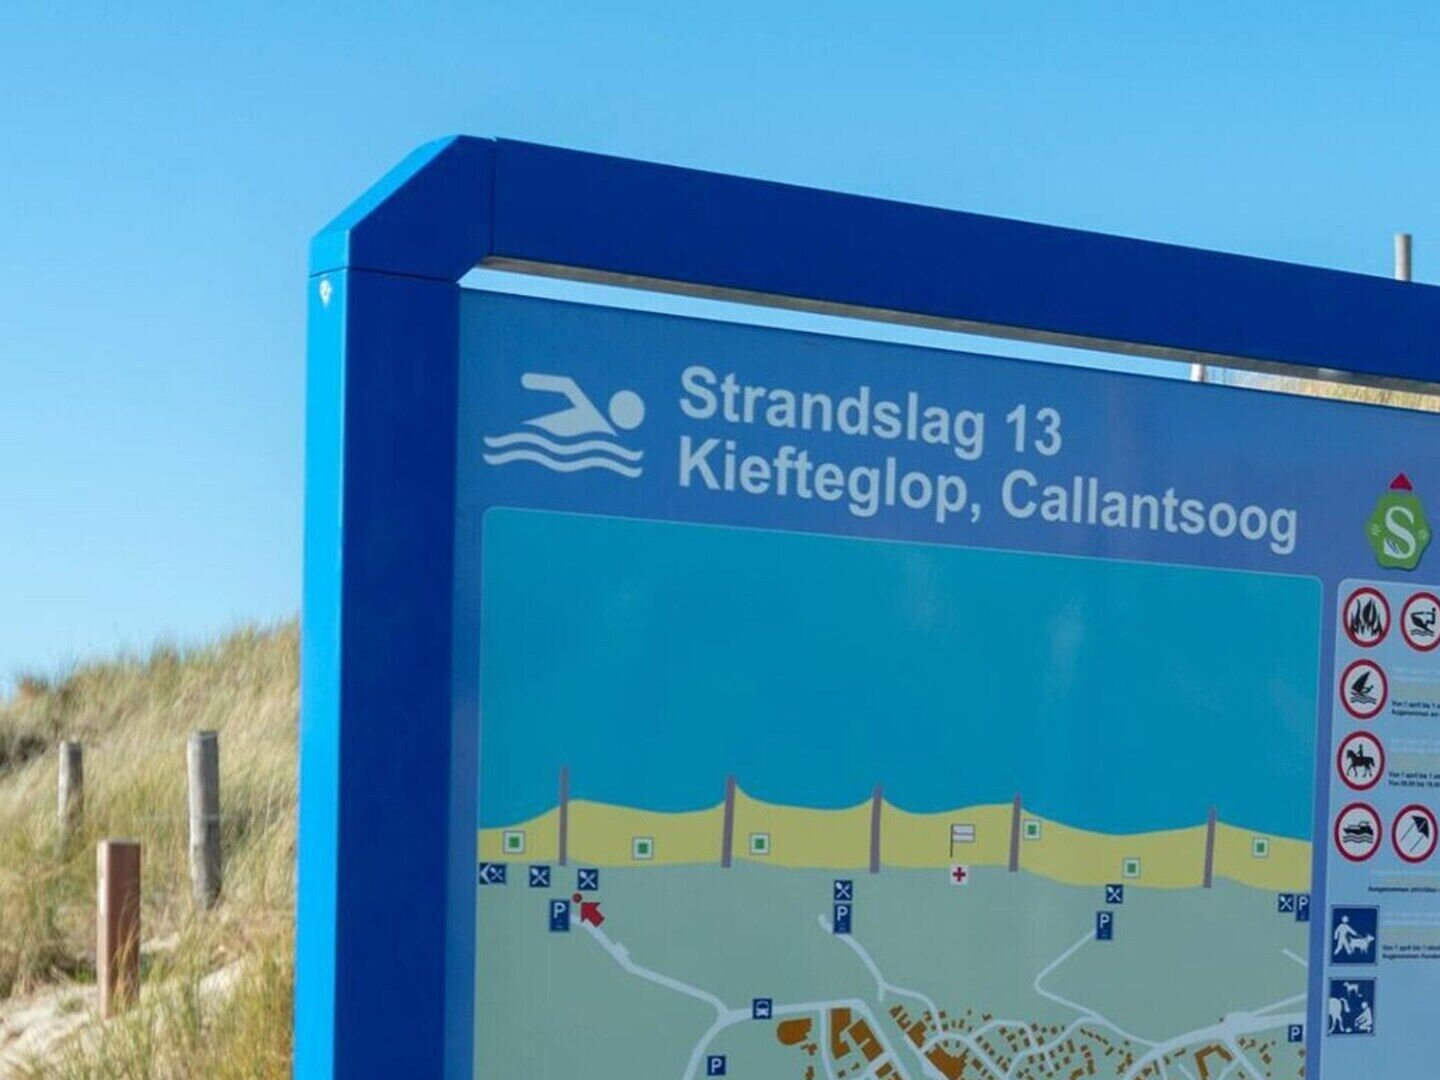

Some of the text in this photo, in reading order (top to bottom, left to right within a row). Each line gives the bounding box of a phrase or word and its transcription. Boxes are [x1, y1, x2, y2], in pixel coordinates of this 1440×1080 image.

[680, 365, 1062, 461] Strandslag 13
[679, 435, 1298, 555] Kiefteglop, Callantsoog
